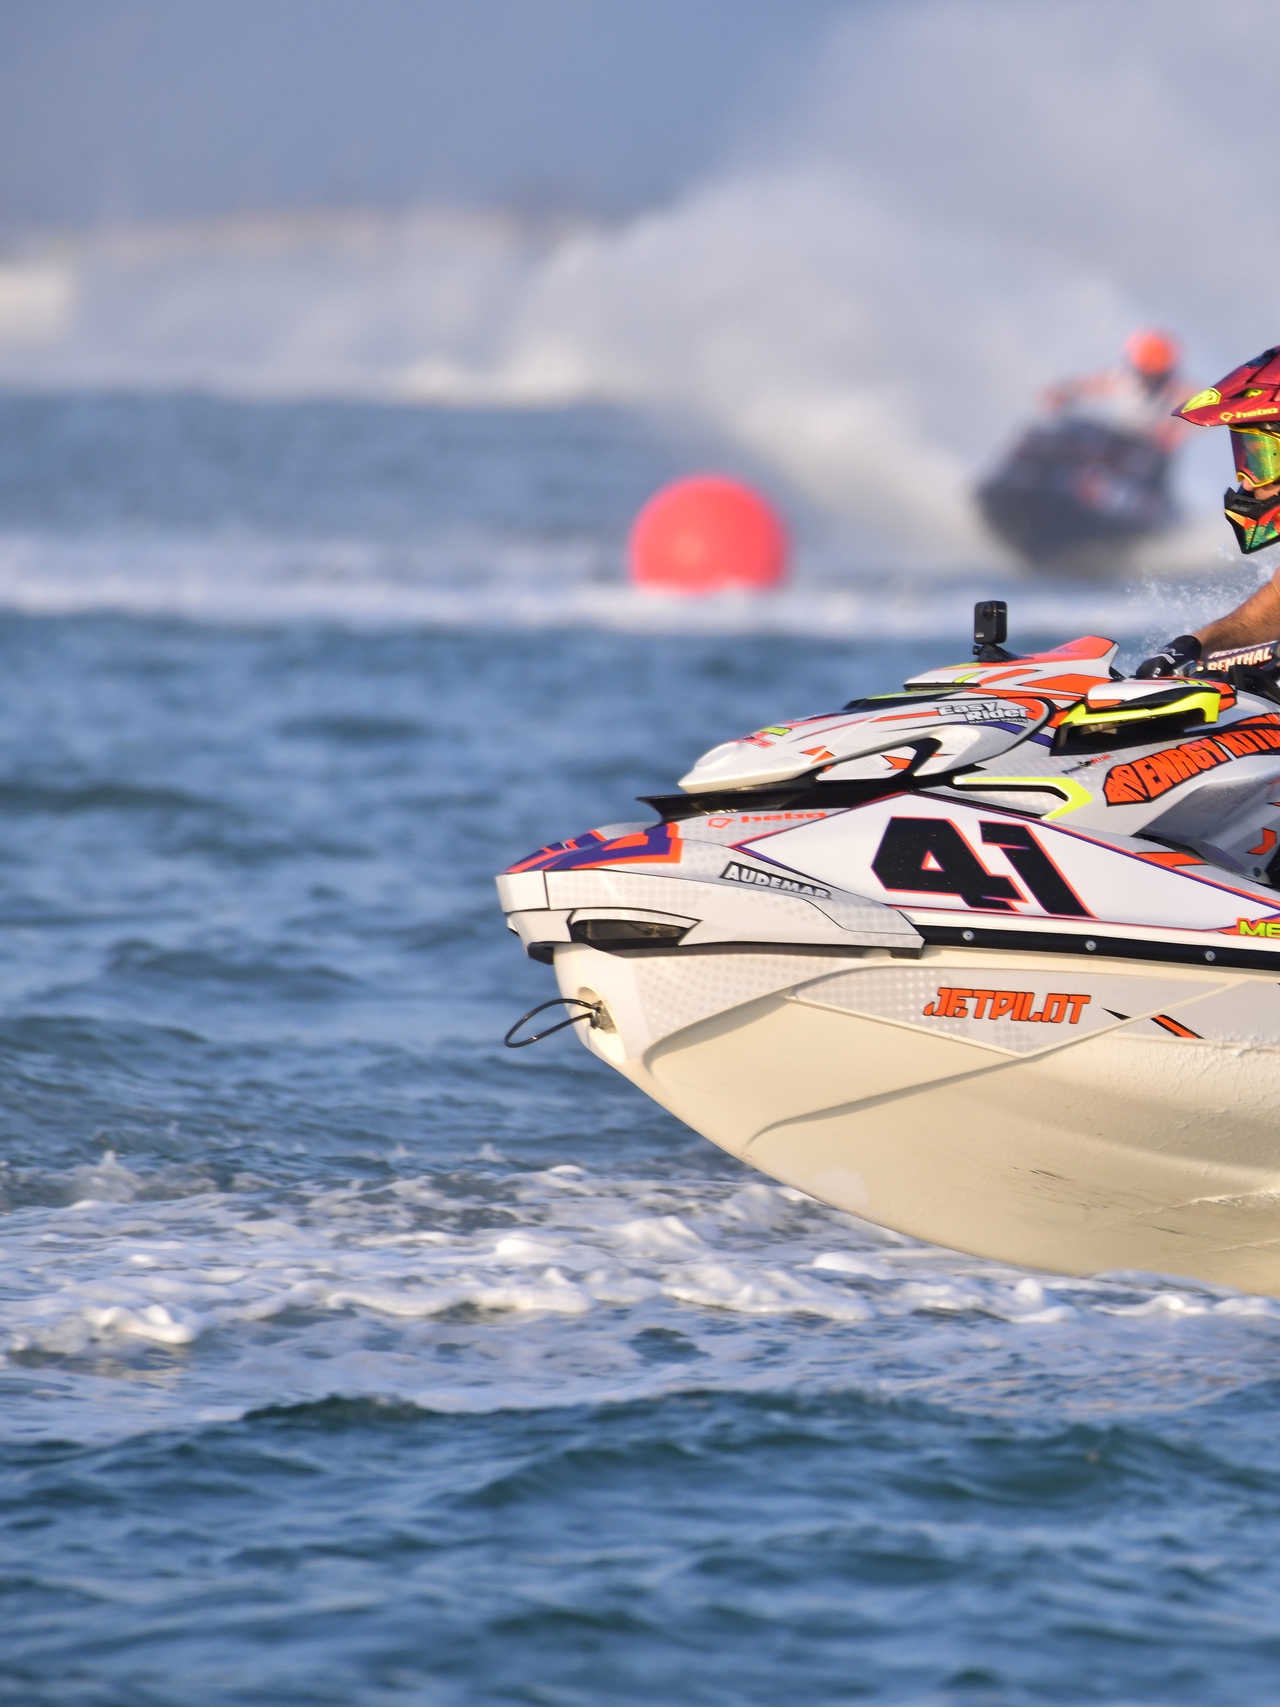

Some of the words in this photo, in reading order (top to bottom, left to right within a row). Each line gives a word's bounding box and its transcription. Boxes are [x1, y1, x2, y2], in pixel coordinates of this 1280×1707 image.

[936, 702, 998, 716] Easy
[965, 708, 1030, 722] Rider
[1138, 737, 1232, 801] ENRGY
[723, 863, 833, 900] AUDEMAR
[870, 816, 1101, 920] 41
[922, 986, 1092, 1025] JETPILOT
